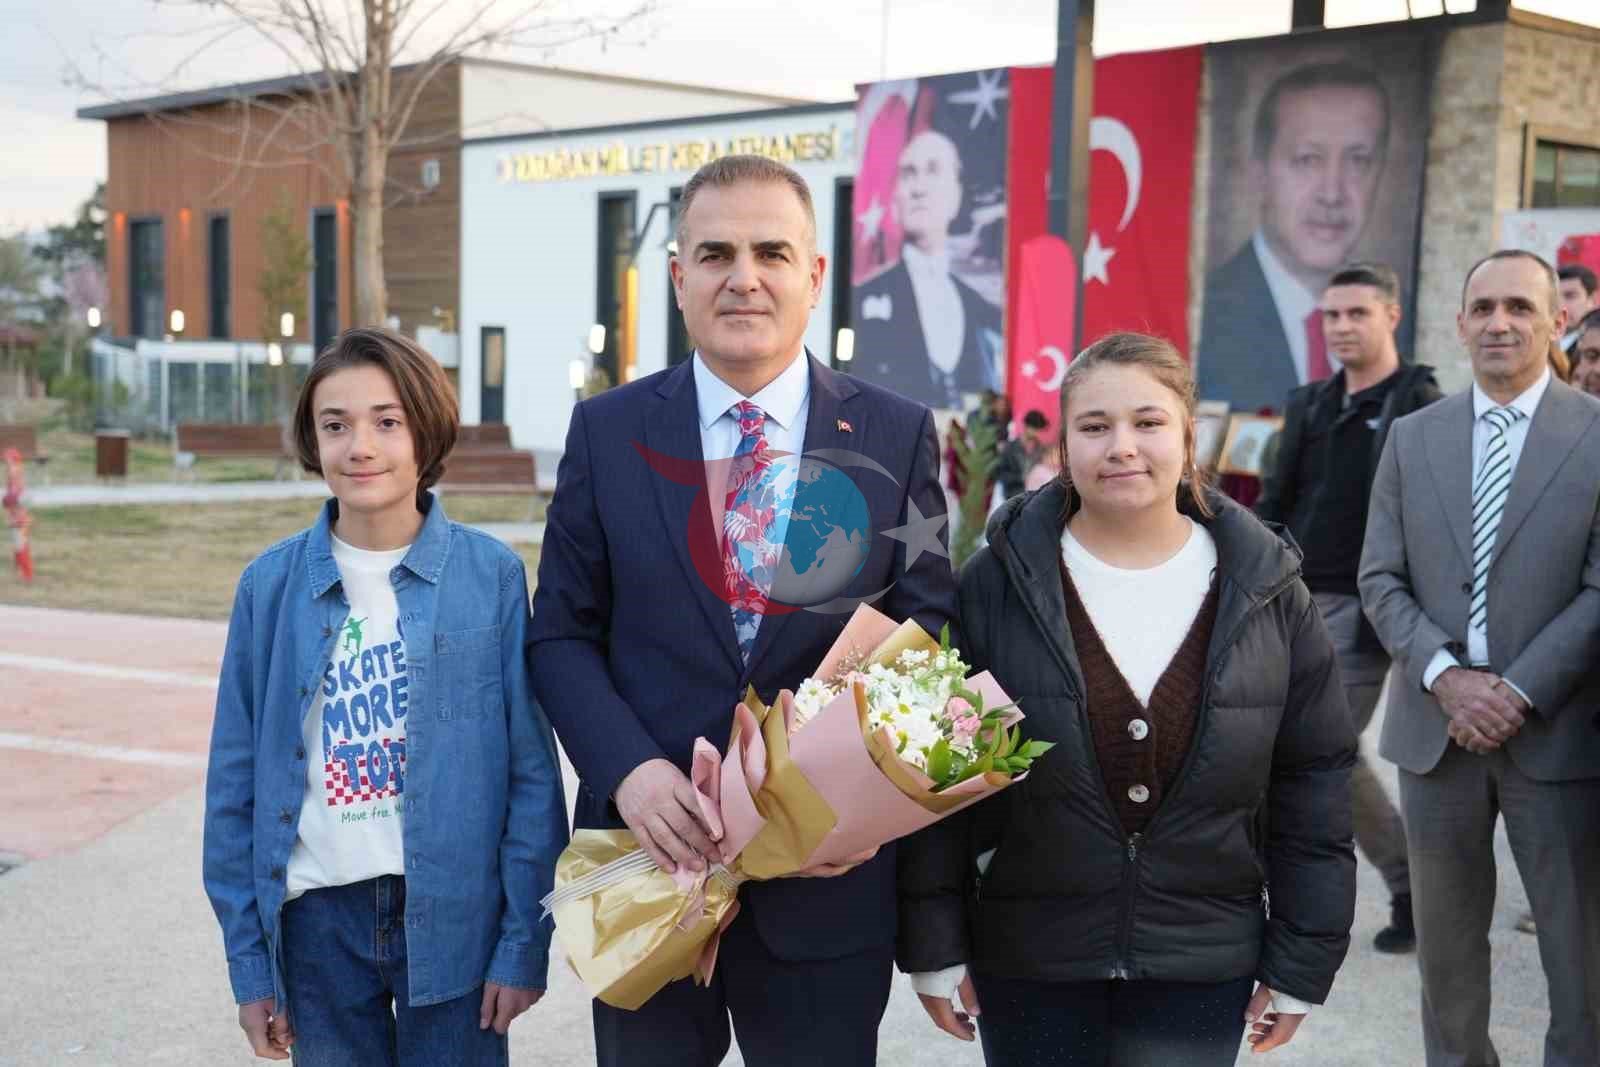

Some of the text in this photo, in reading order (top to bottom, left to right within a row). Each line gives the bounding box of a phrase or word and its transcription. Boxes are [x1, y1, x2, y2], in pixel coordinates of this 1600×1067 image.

[323, 641, 406, 697] SKATE
[323, 676, 408, 762] MORE
[341, 811, 368, 824] Move
